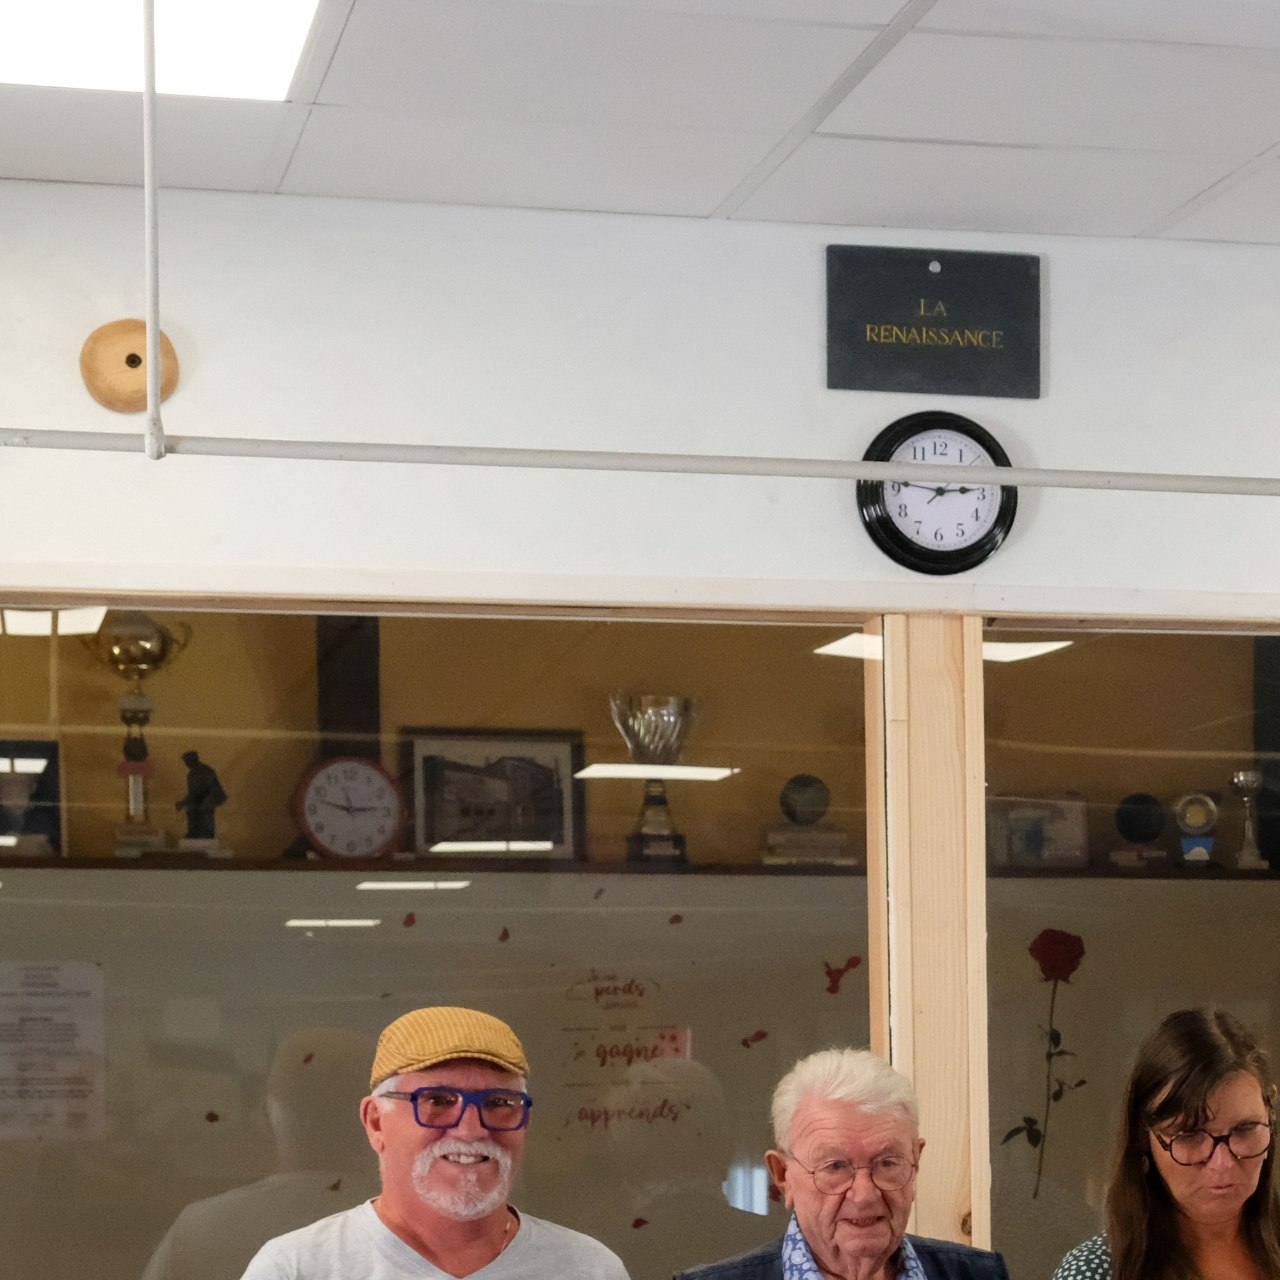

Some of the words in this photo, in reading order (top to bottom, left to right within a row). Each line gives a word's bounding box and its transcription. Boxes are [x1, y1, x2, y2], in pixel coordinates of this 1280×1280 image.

[919, 298, 947, 316] LA
[865, 323, 1004, 348] RENAISSANCE
[912, 446, 925, 460] 11
[933, 441, 948, 456] 12
[958, 448, 964, 463] 1
[891, 481, 901, 497] 9
[976, 487, 986, 501] 3
[898, 503, 908, 518] 8
[970, 507, 980, 521] 4
[914, 520, 922, 535] 7
[933, 527, 944, 542] 6
[956, 523, 965, 537] 5
[594, 978, 645, 1001] perds
[596, 1043, 661, 1067] gagne
